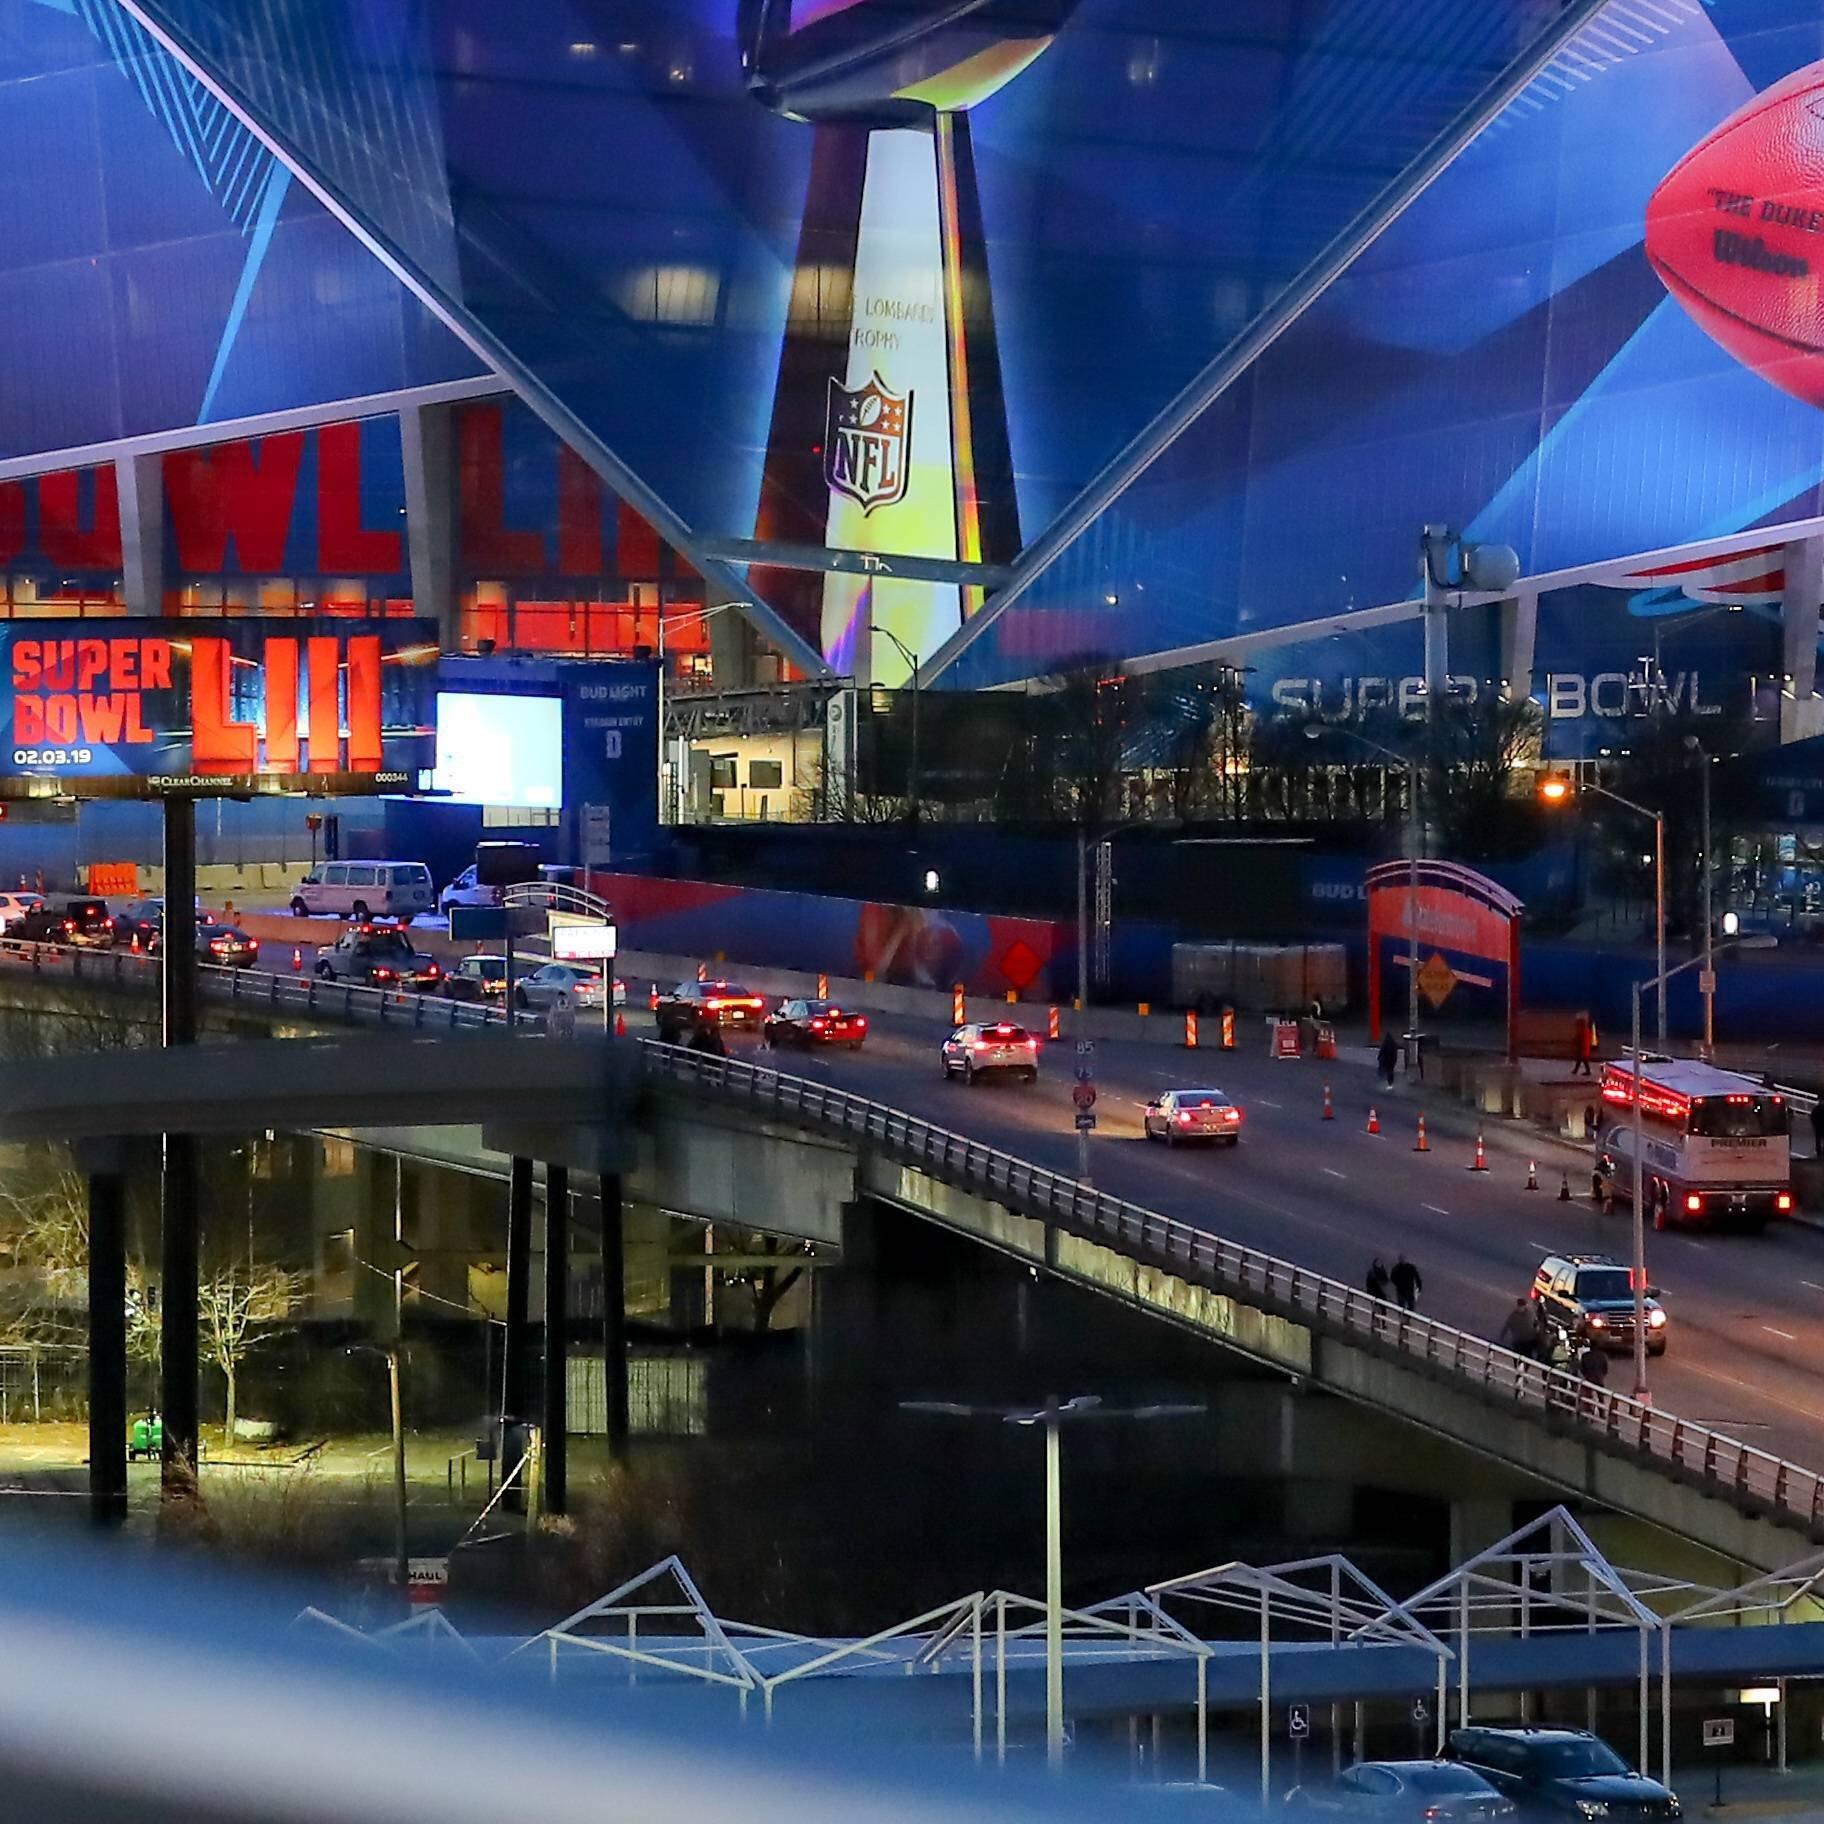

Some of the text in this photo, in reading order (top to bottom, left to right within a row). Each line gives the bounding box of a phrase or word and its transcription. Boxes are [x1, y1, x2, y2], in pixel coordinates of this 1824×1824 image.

[833, 432, 895, 494] NFL
[12, 635, 382, 774] SUPER LIII
[580, 685, 608, 700] BUD
[1549, 671, 1723, 719] BOWL
[13, 693, 155, 745] BOWL
[14, 749, 92, 765] 02.03.19
[1312, 882, 1355, 899] BUD
[1711, 1138, 1768, 1148] PREMIER
